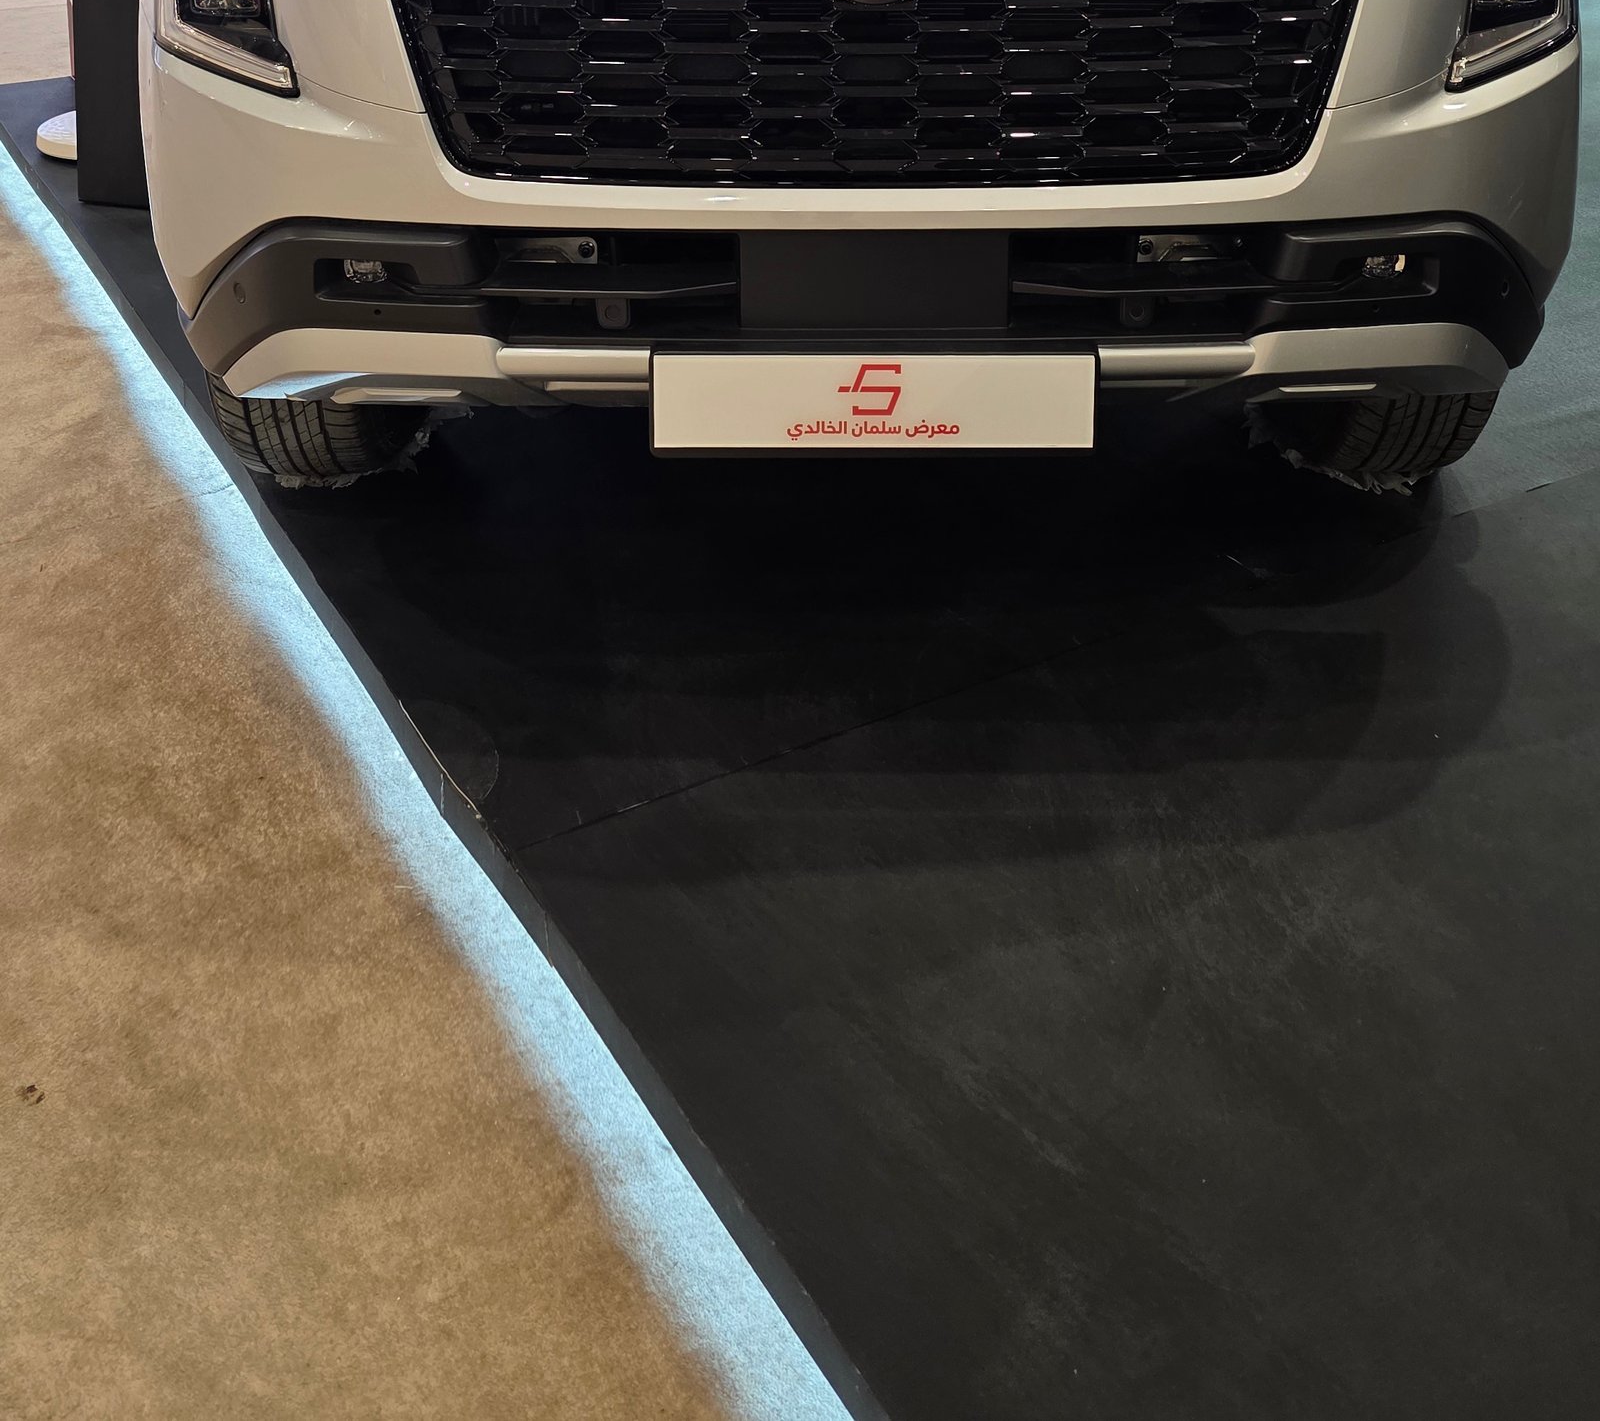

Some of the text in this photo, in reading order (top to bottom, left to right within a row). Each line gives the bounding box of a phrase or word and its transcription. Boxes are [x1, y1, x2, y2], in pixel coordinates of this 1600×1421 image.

[787, 419, 960, 441] معرض سلمان الخالدي
